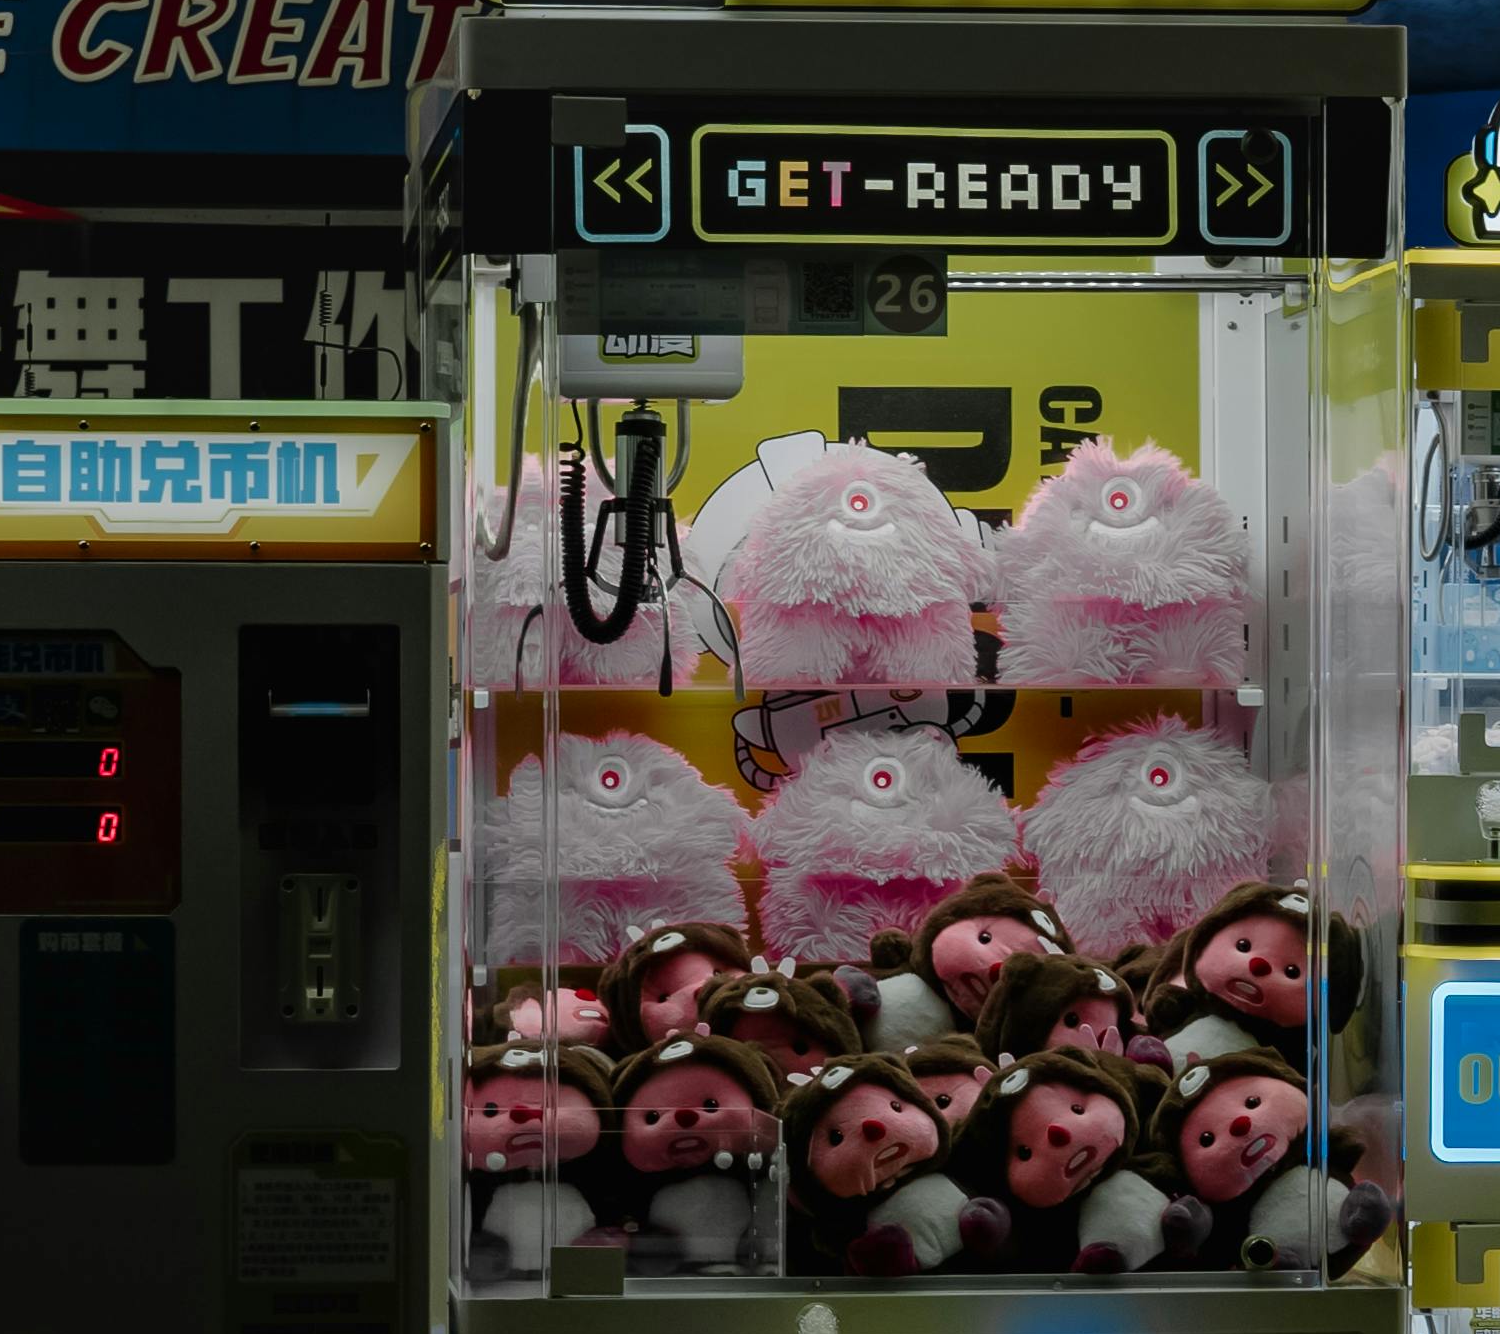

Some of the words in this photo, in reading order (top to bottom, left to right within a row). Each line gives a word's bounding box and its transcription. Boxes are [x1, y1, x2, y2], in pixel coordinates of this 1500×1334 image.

[727, 158, 1142, 211] GET-READY
[874, 272, 939, 314] 26
[1, 440, 341, 505] 自助兑币机
[97, 746, 121, 778] 0
[96, 810, 120, 843] 0
